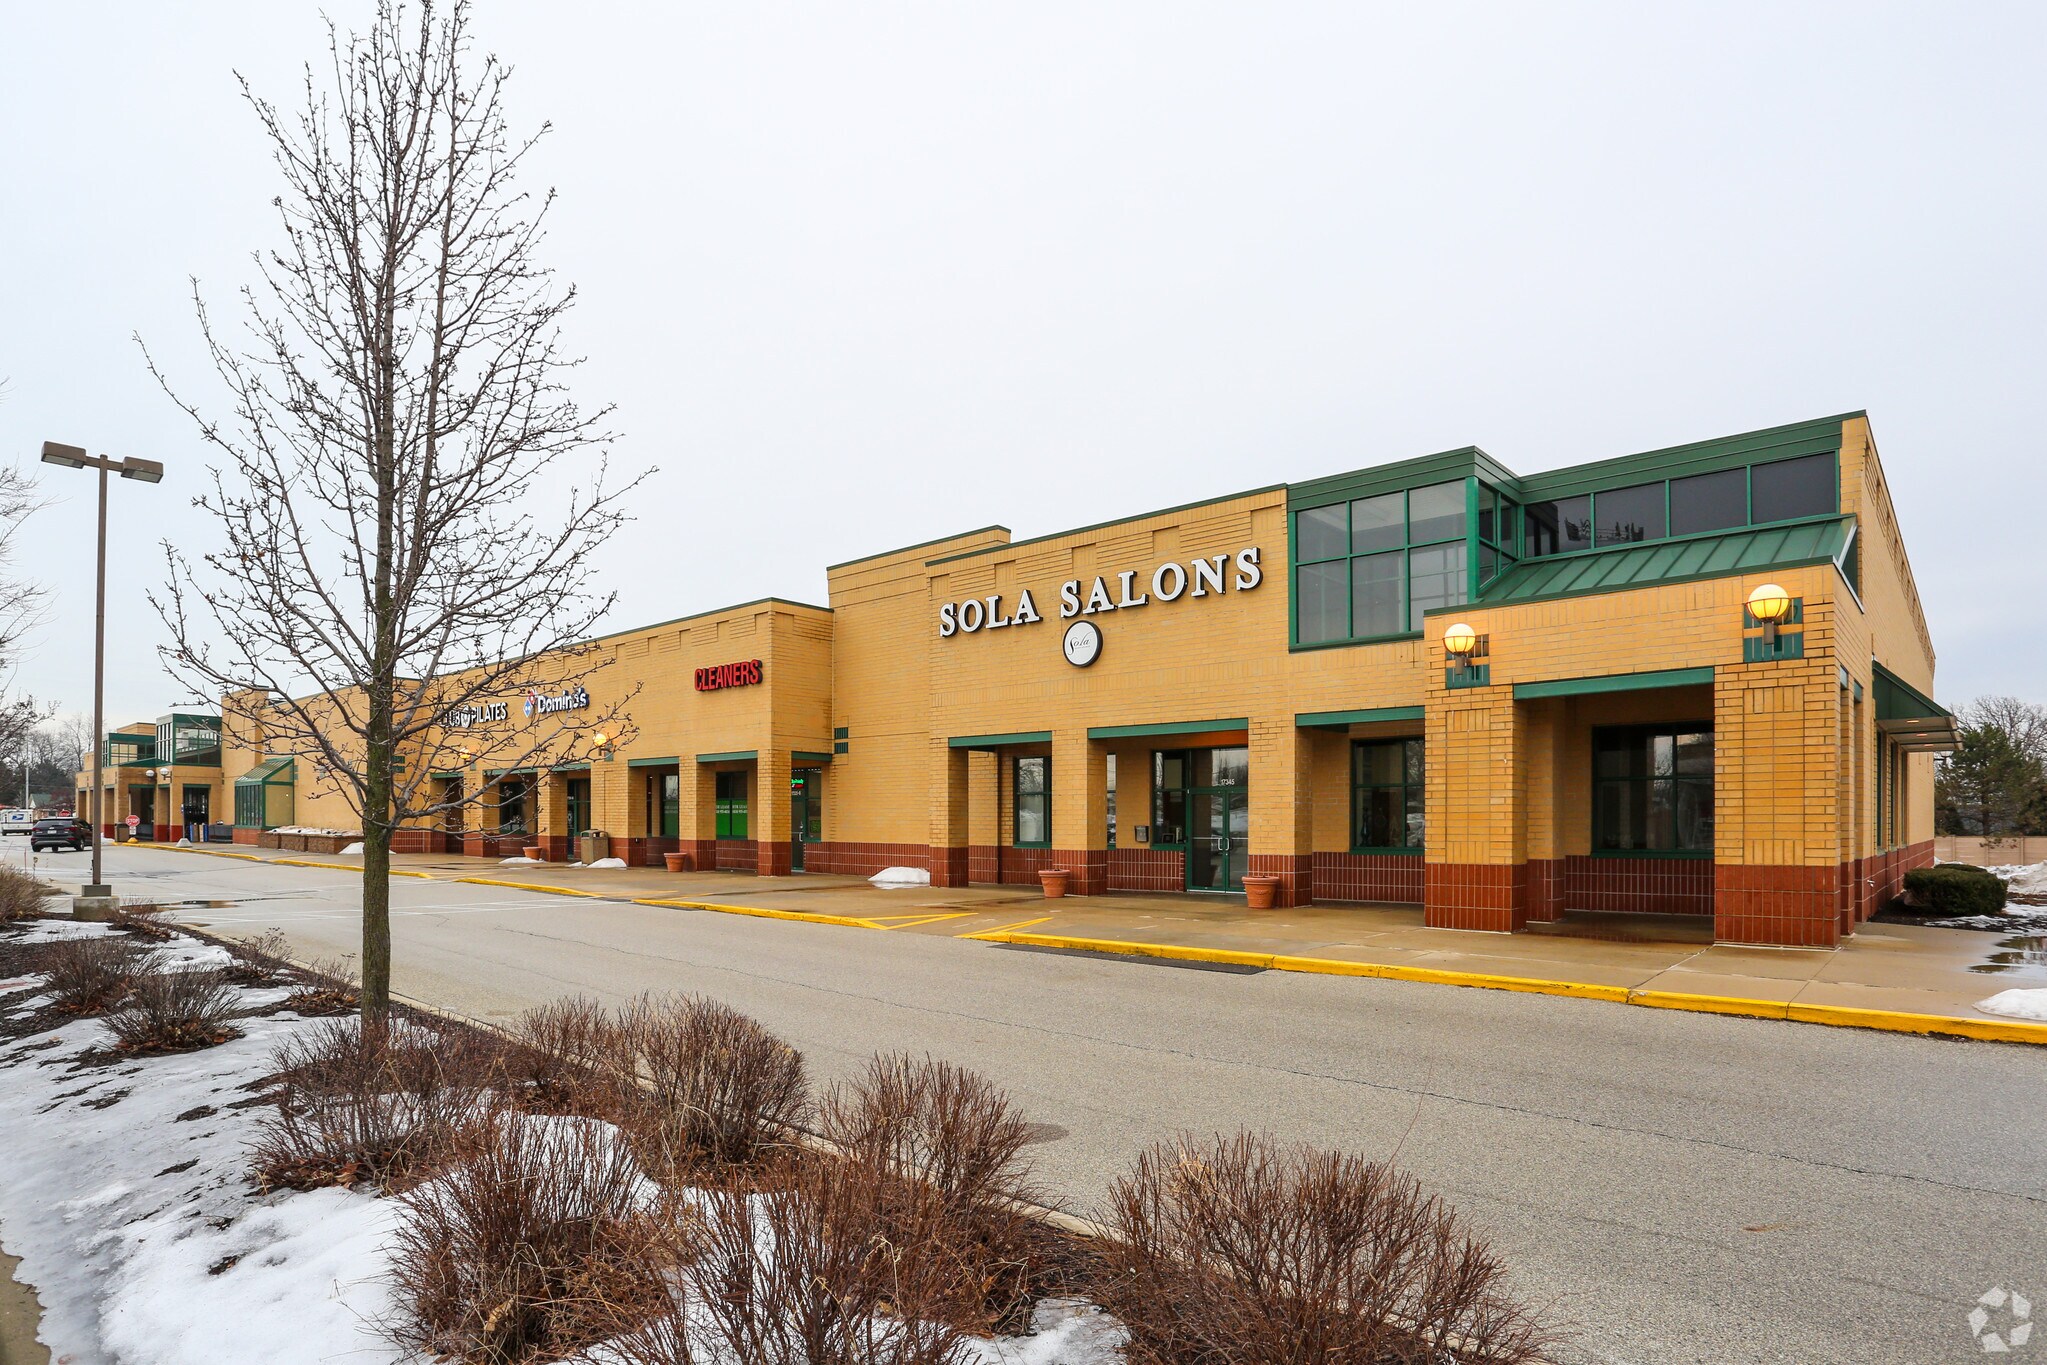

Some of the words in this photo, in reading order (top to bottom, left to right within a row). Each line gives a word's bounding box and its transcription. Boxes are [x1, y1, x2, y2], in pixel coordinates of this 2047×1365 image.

[939, 589, 1043, 638] SOLA
[1060, 546, 1263, 618] SALONS
[1067, 631, 1094, 656] Sola
[694, 659, 763, 691] CLEANERS
[471, 702, 508, 724] PILATES
[536, 687, 589, 714] Domino's
